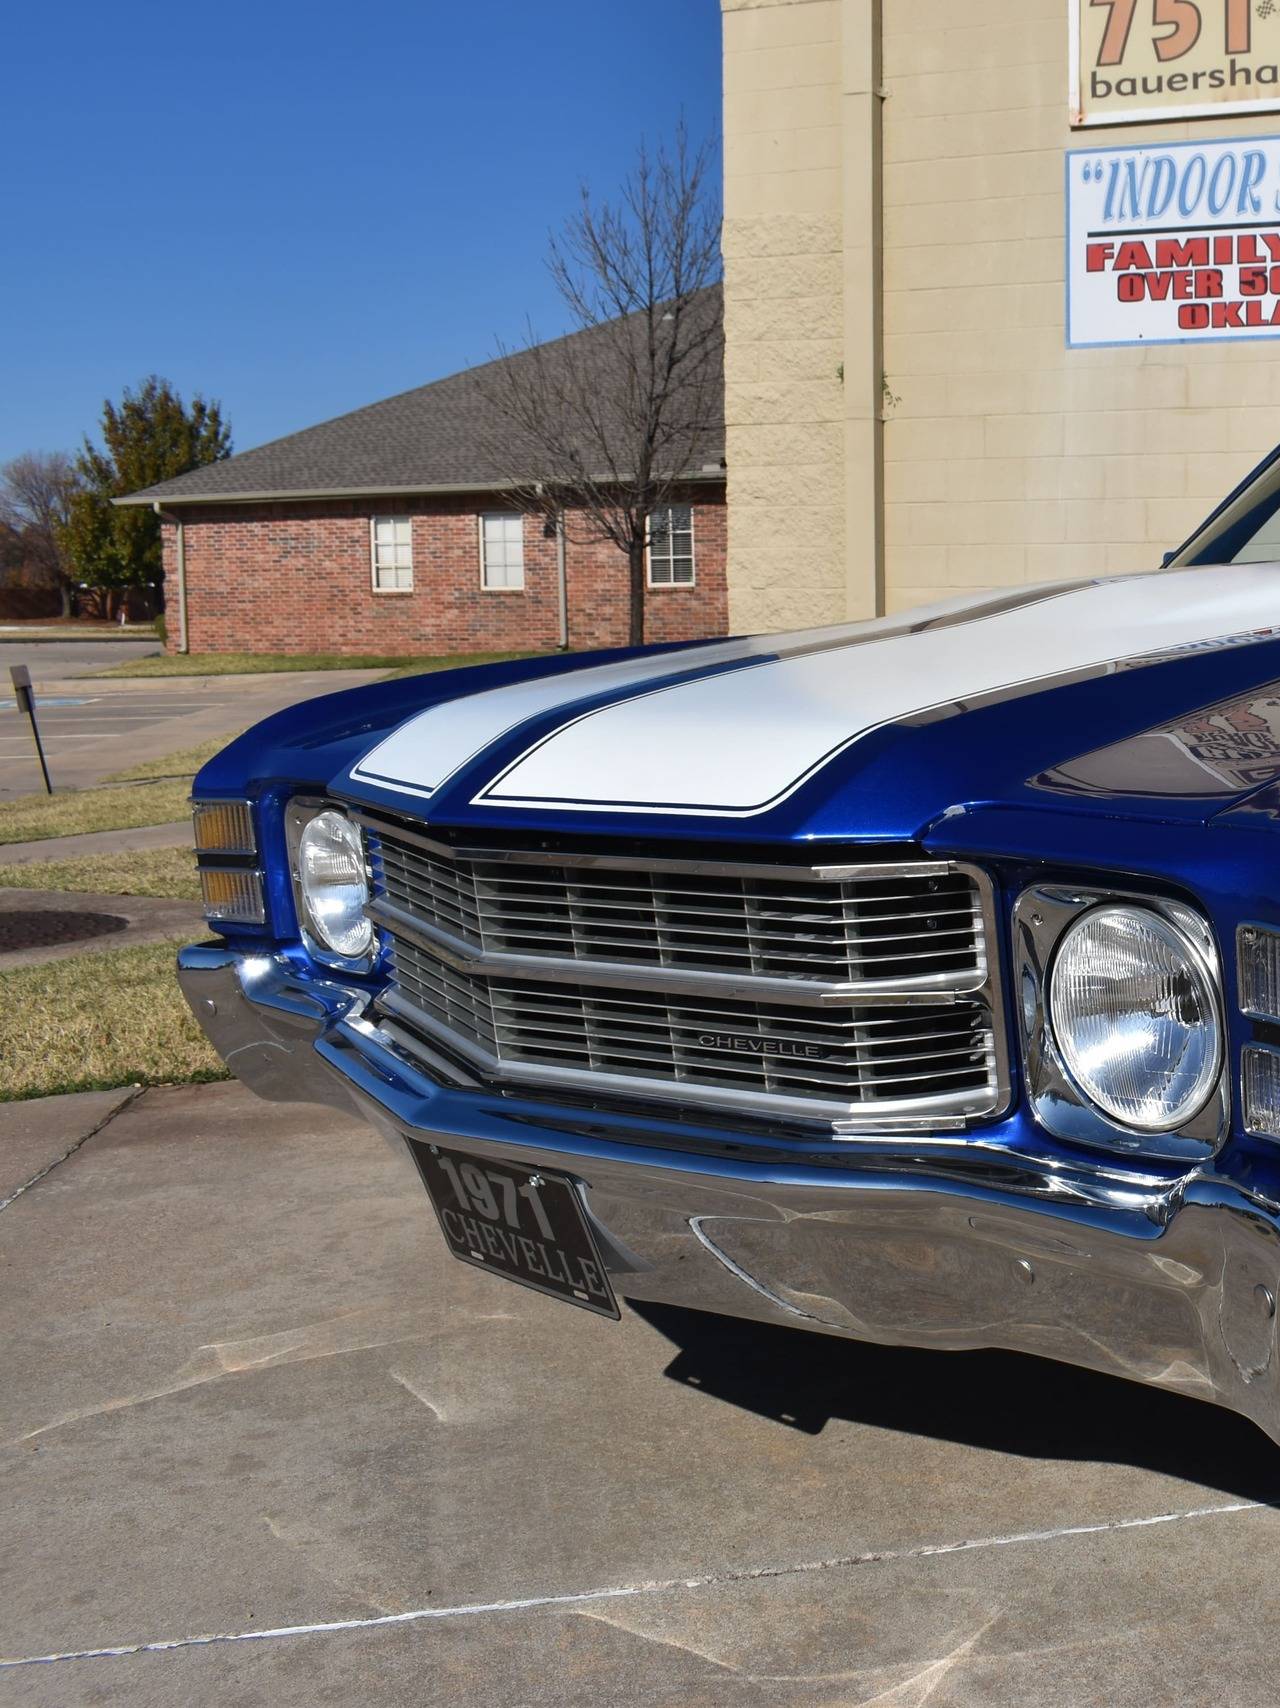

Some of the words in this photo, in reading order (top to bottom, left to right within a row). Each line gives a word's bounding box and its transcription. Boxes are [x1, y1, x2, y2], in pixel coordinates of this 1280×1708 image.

[1117, 268, 1223, 302] OVER
[698, 1034, 820, 1058] CHEVELLE
[437, 1155, 557, 1242] 1971
[441, 1207, 608, 1299] CHEVELLE
